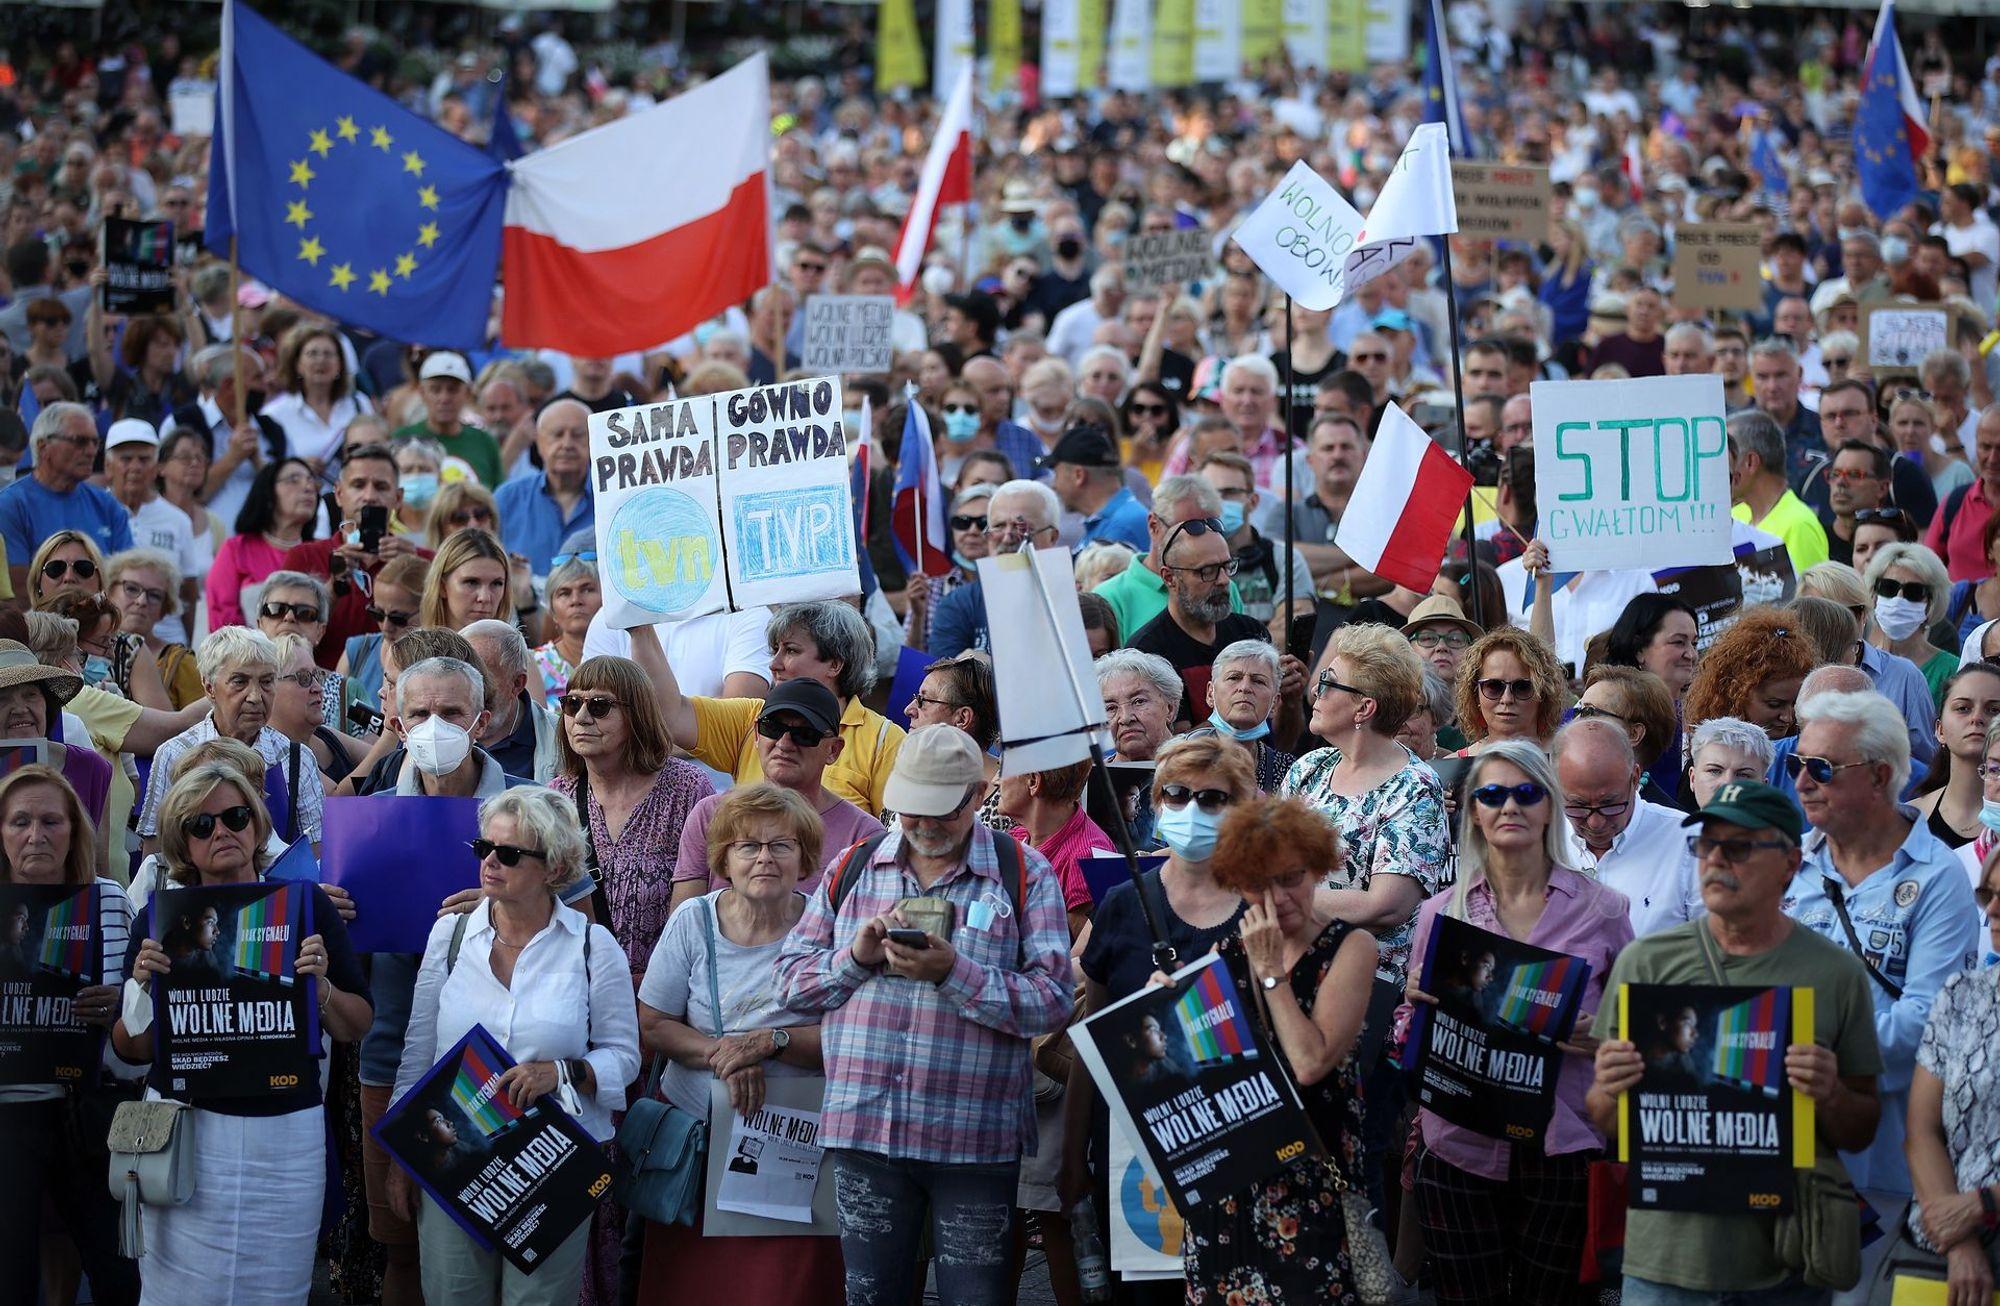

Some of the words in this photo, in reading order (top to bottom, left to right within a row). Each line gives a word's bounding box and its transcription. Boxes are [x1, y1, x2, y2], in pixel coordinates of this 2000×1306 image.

[1280, 181, 1354, 256] WOLNO
[1276, 226, 1344, 293] OBOW
[727, 380, 833, 428] GÓWNO
[606, 401, 699, 449] SAMA
[727, 421, 846, 470] PRAWDA
[1556, 416, 1726, 502] STOP
[596, 440, 713, 493] PRAWDA
[747, 502, 832, 570] TVP
[1550, 506, 1681, 540] GWAŁTOM
[619, 529, 712, 590] tvn
[1719, 784, 1744, 803] H
[4, 982, 32, 995] LUDZIE
[168, 989, 196, 1003] WOLNI
[200, 988, 230, 1002] LUDZIE
[2, 996, 33, 1026] LNE
[168, 1003, 234, 1035] WOLNE
[238, 1001, 296, 1034] MEDIA
[55, 1066, 82, 1078] KOD
[1432, 1022, 1487, 1074] WOLNE
[1487, 1049, 1544, 1087] MEDIA
[270, 1074, 298, 1086] KOD
[1143, 1101, 1174, 1125] WOLNI
[1173, 1085, 1205, 1110] LUDZIE
[1150, 1098, 1223, 1153] WOLNE
[1214, 1071, 1280, 1124] MEDIA
[785, 1116, 819, 1147] MEDI
[1506, 1124, 1535, 1138] KOD
[1640, 1109, 1712, 1145] WOLNE
[1715, 1111, 1779, 1148] MEDIA
[1276, 1140, 1306, 1162] KOD
[457, 1179, 484, 1204] WOLNI
[479, 1155, 507, 1184] LUDZIE
[468, 1163, 531, 1225] WOLNE
[514, 1124, 573, 1180] MEDIA
[588, 1173, 612, 1197] KOD
[1749, 1193, 1781, 1206] KOD
